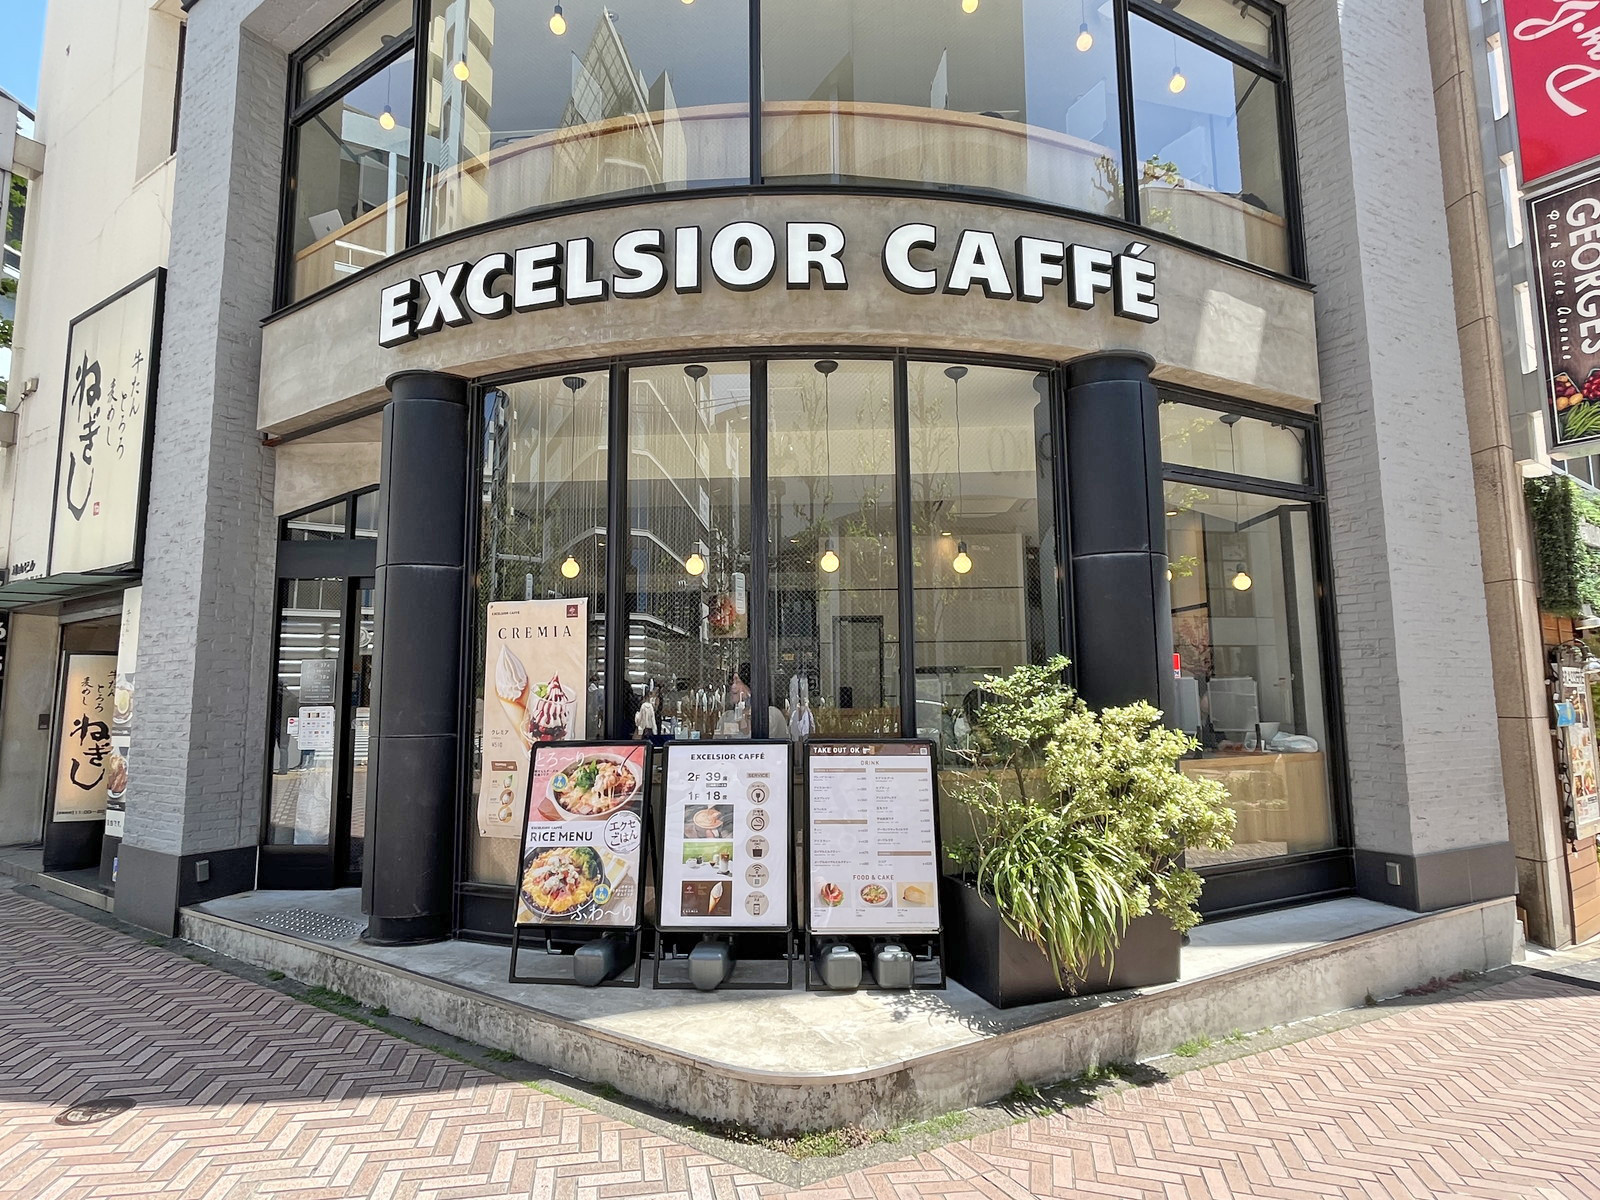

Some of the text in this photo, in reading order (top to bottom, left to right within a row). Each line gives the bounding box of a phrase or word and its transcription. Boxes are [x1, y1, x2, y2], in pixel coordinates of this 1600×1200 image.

[378, 221, 1160, 348] EXCELSIOR CAFFÉ
[1546, 210, 1572, 361] Park Side Avenue
[1566, 197, 1600, 355] GEORGES
[129, 349, 144, 418] 牛たん
[106, 378, 119, 447] 麦めし
[116, 391, 128, 461] とろろ
[67, 349, 103, 522] ねぎし
[498, 625, 572, 640] CREMIA
[81, 676, 94, 706] 麦めし
[94, 683, 105, 714] とろろ
[69, 712, 112, 791] ねぎし
[690, 752, 766, 761] EXCELSIOR CAFFÉ
[813, 746, 861, 754] TAKE OUT OK
[687, 772, 701, 782] 2F
[688, 791, 700, 800] 1F
[530, 831, 593, 842] RICE MENU
[609, 819, 636, 832] エクセ
[610, 829, 639, 847] ごはん
